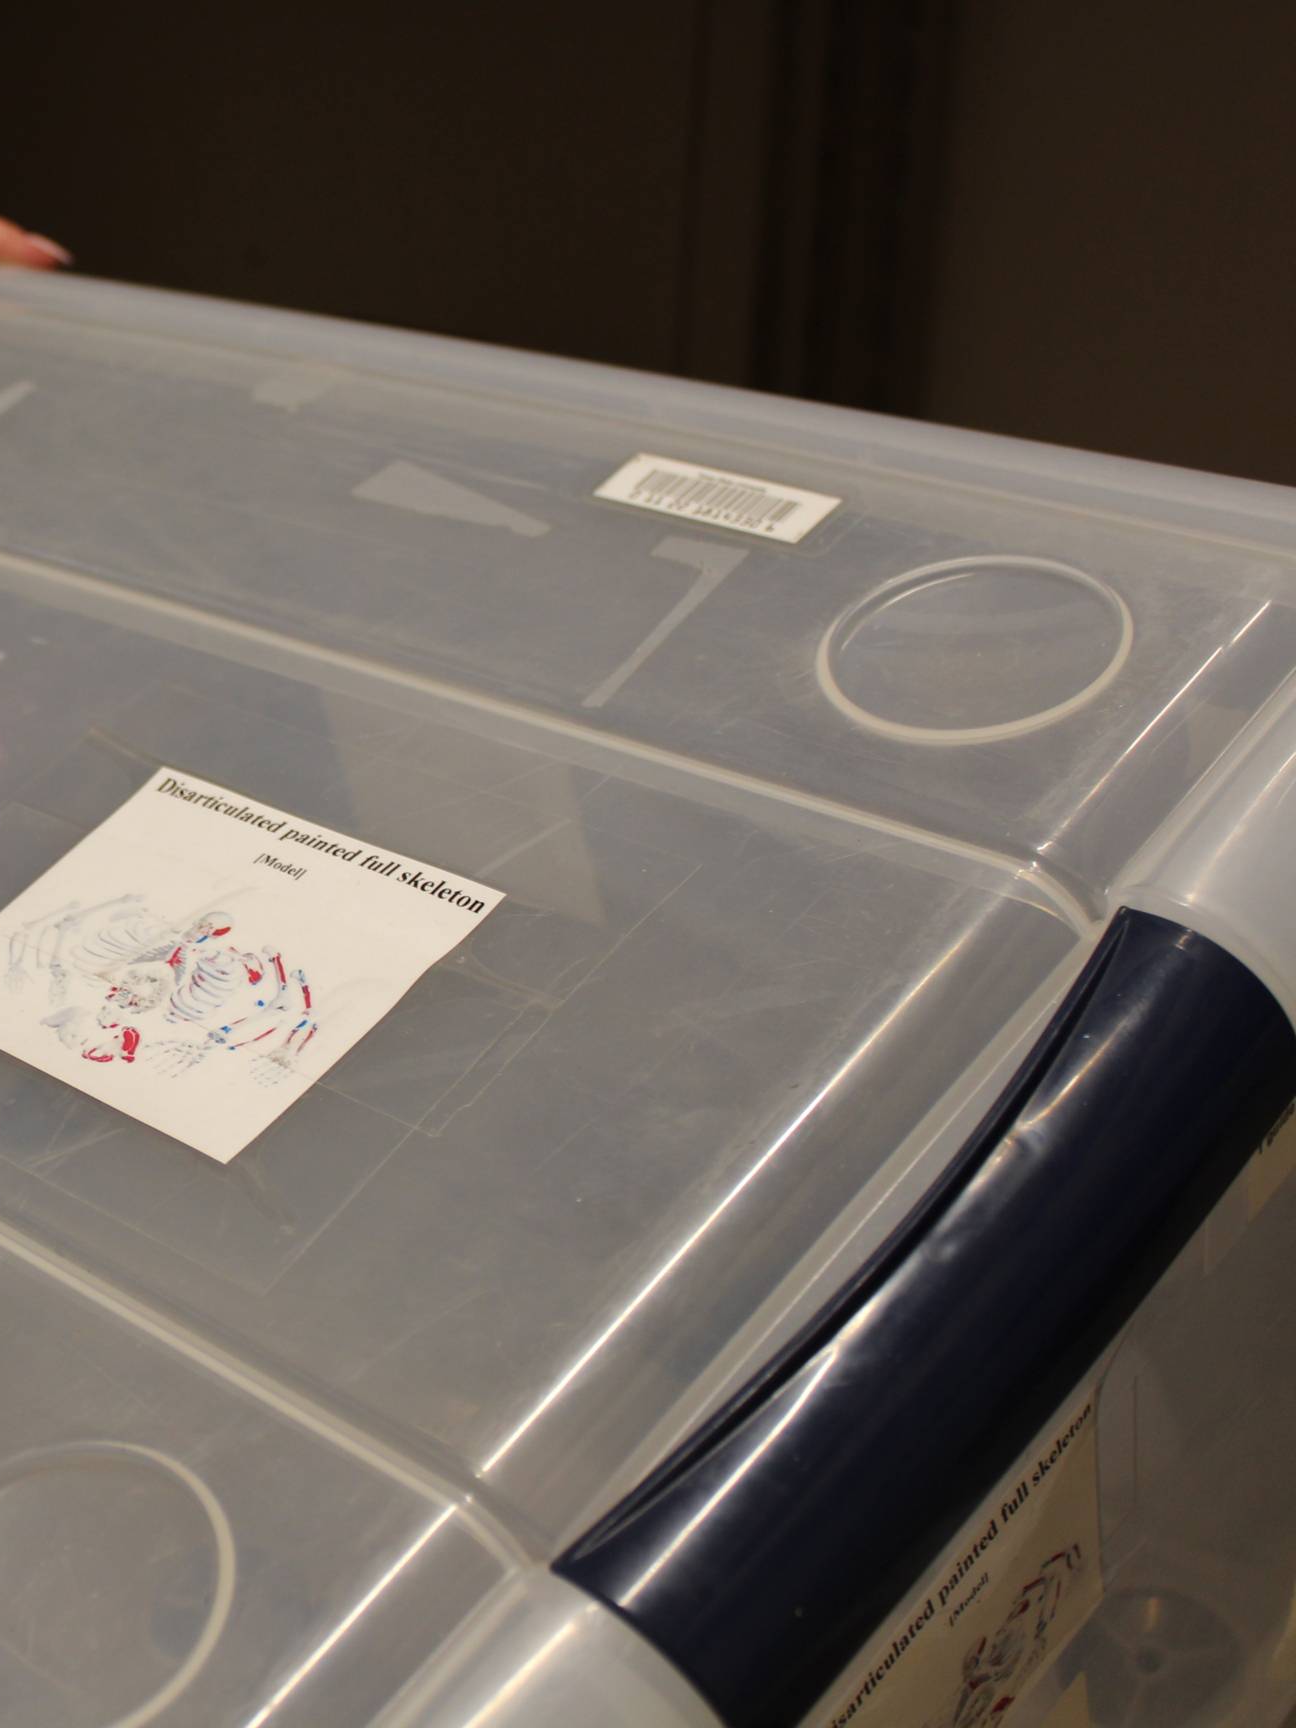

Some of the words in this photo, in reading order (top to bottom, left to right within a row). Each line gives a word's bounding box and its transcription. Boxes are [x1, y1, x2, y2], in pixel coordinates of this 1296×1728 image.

[157, 778, 285, 834] Disarticulated
[280, 821, 362, 863] painted
[358, 855, 401, 878] full
[397, 870, 487, 914] skeleton
[830, 1600, 936, 1728] isarticulated
[936, 1520, 999, 1606] painted
[1001, 1481, 1030, 1523] full
[1032, 1403, 1092, 1487] skeleton
